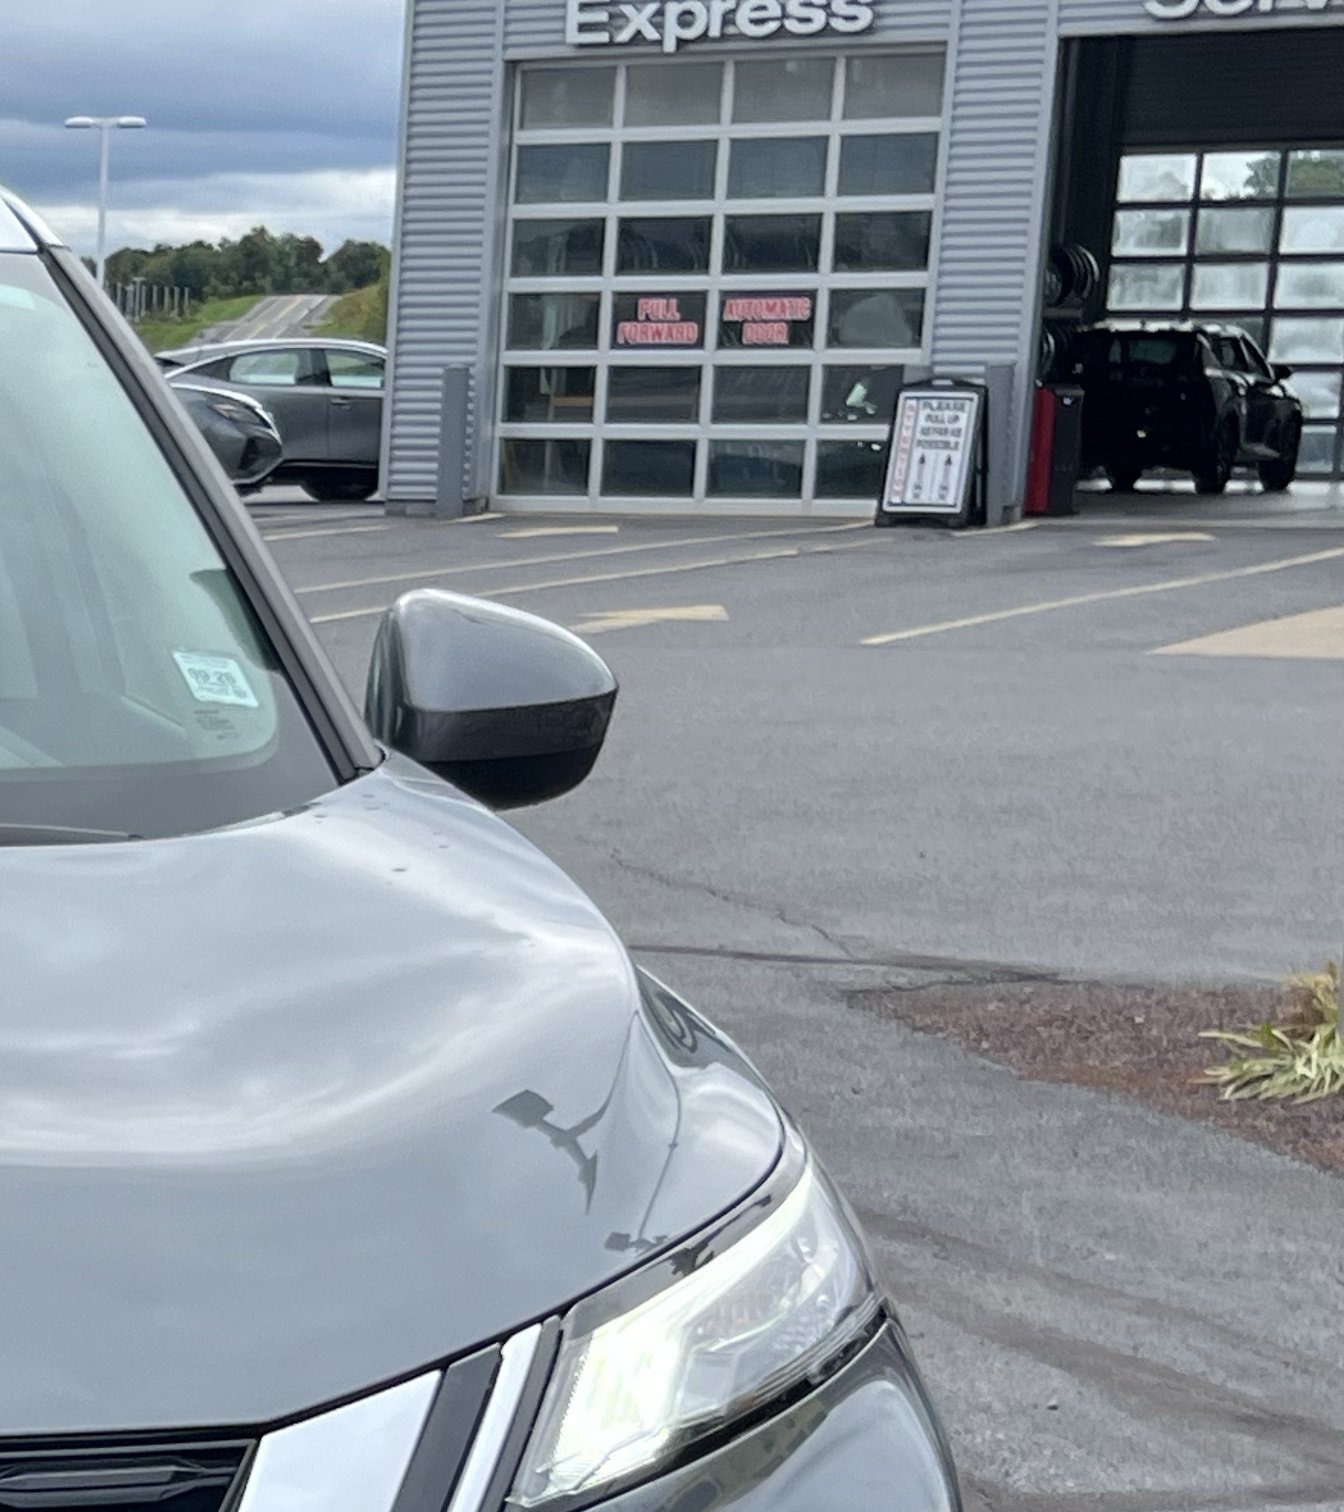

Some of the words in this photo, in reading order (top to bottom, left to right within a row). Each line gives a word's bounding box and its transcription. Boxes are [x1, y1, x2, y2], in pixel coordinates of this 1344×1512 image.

[565, 0, 874, 53] Express
[638, 299, 681, 321] PULL
[723, 298, 811, 321] AUTOMATIC
[617, 322, 699, 344] FORWARD
[922, 401, 965, 411] PLEASE
